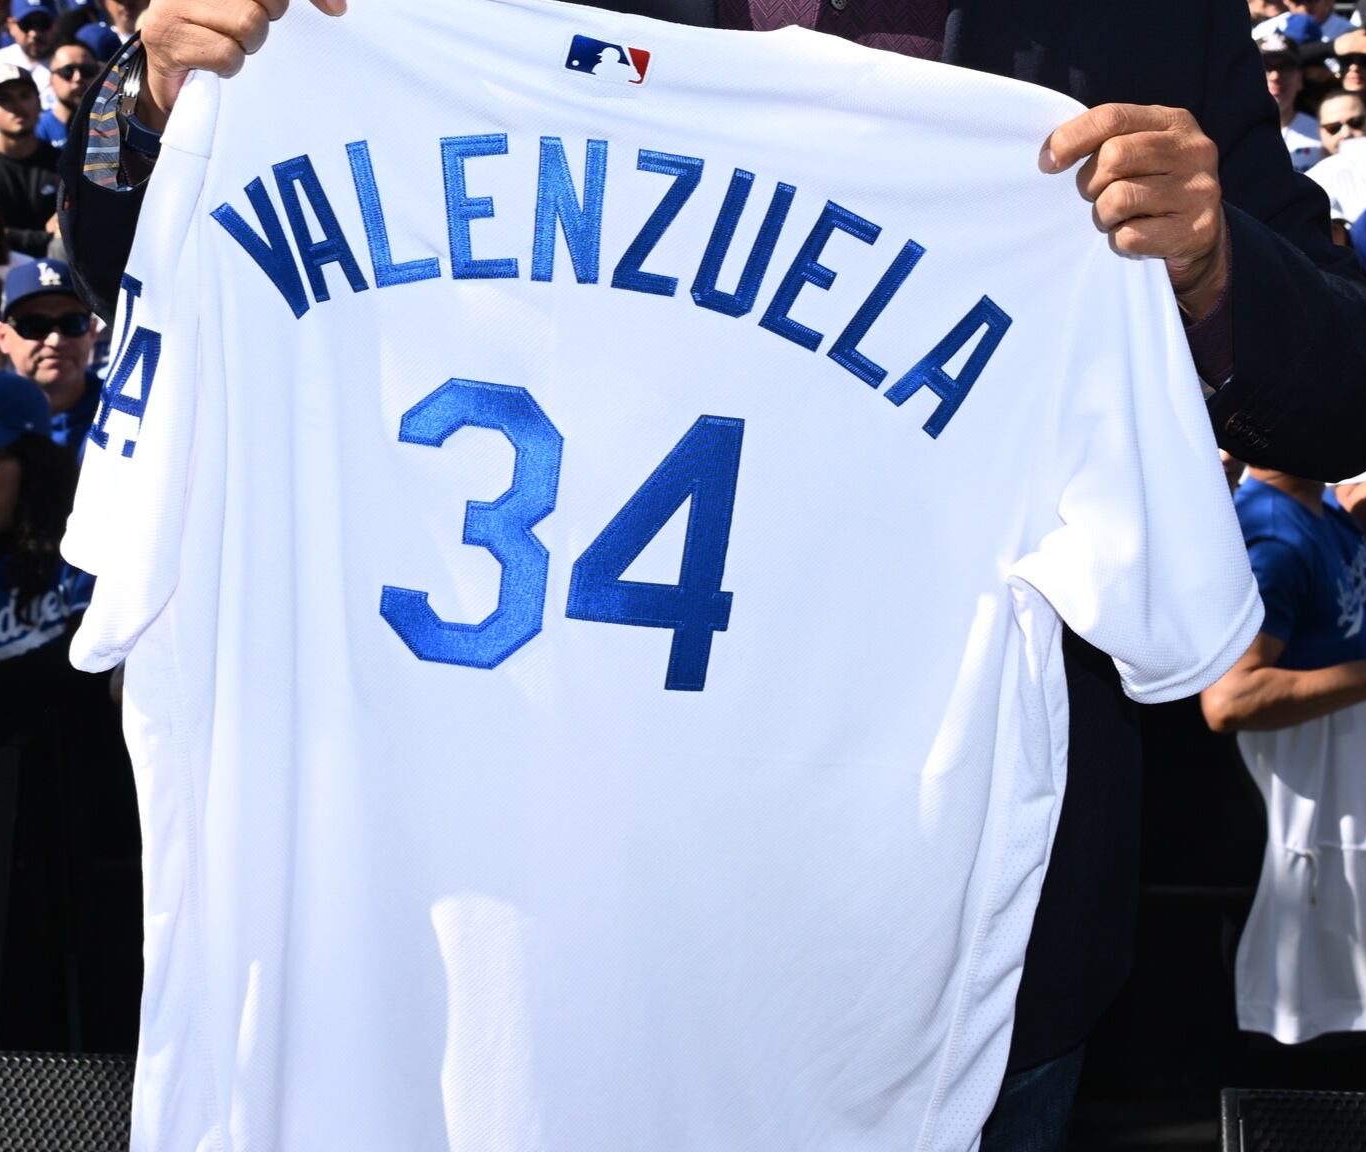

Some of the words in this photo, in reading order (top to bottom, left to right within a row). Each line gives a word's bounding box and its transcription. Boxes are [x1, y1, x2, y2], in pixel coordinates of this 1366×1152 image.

[37, 262, 61, 287] LA
[210, 133, 1013, 439] VALENZUELA
[378, 377, 747, 693] 34
